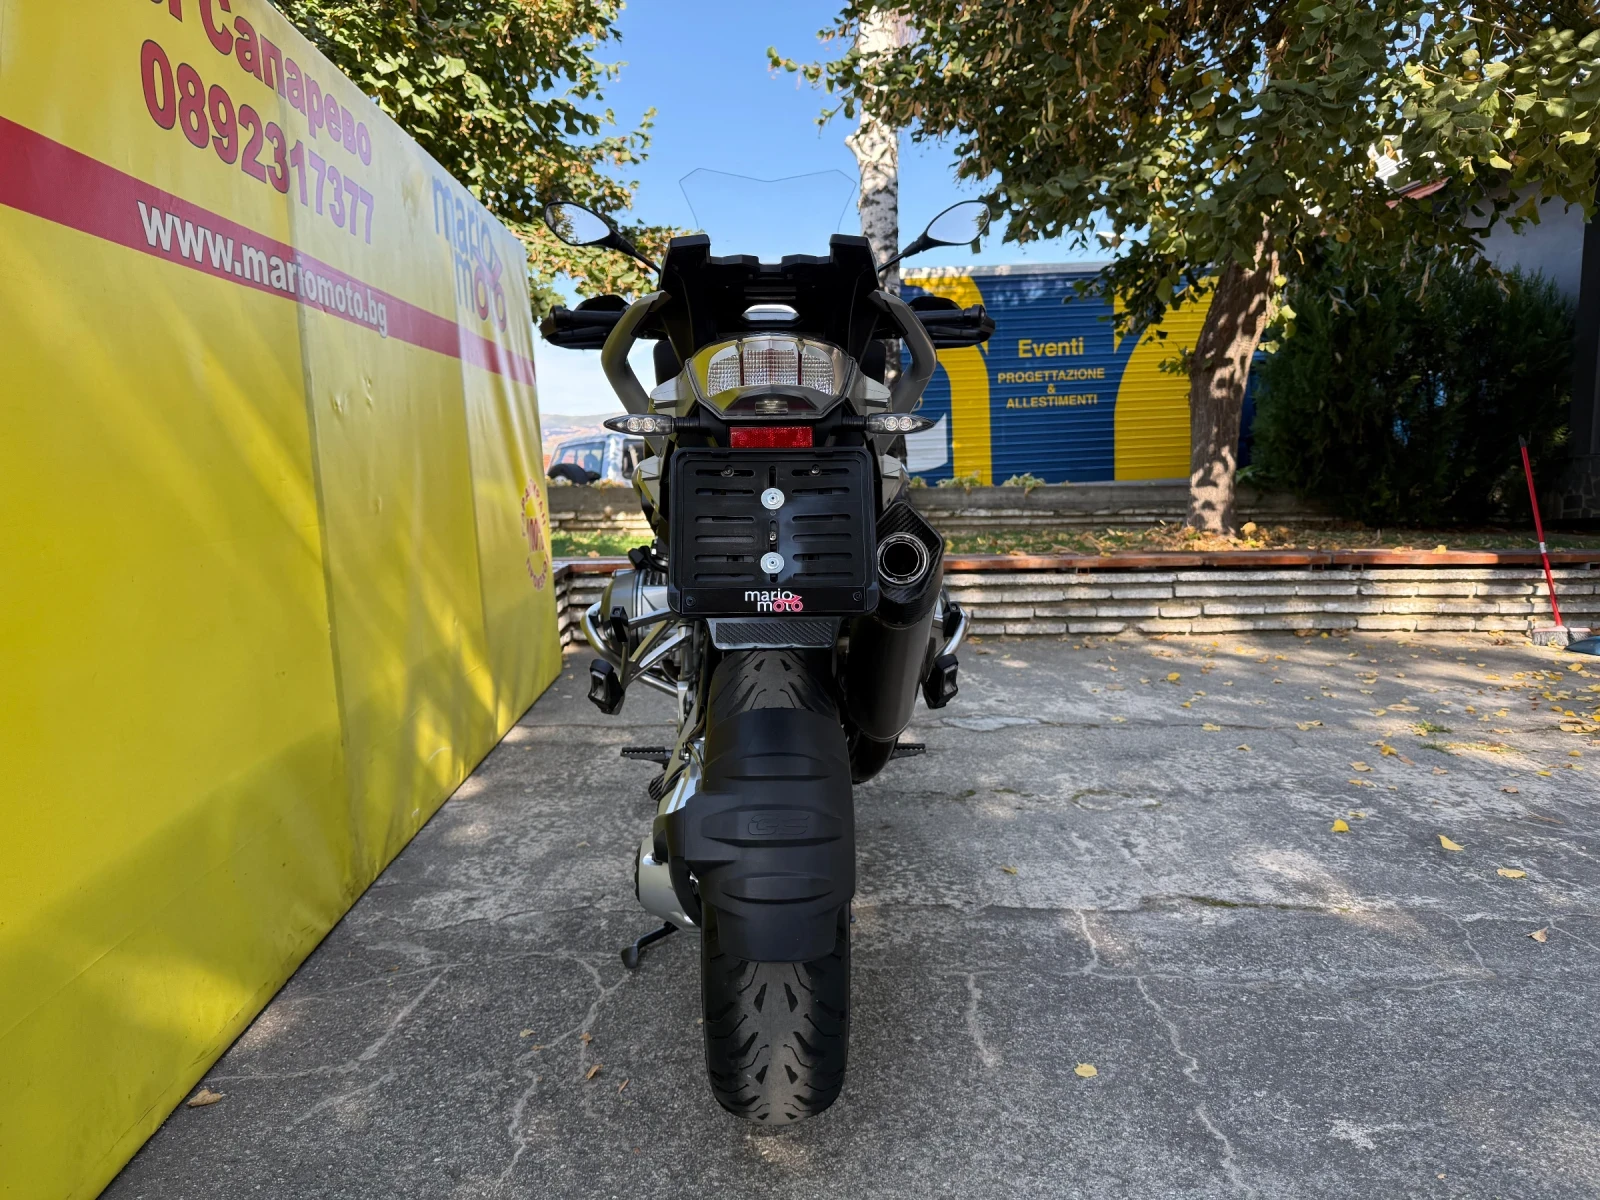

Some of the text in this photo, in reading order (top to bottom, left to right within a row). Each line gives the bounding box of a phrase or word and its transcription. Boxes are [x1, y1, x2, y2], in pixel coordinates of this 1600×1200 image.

[140, 39, 374, 245] 0892317377
[432, 175, 494, 272] mario
[136, 200, 389, 338] www.mariomoto.bg
[1018, 337, 1084, 358] Eventi
[998, 368, 1105, 383] PROGETTAZIONE
[1047, 384, 1056, 394] &
[1006, 395, 1098, 408] ALLESTIMENTI
[744, 588, 793, 602] mario
[757, 601, 804, 612] moto
